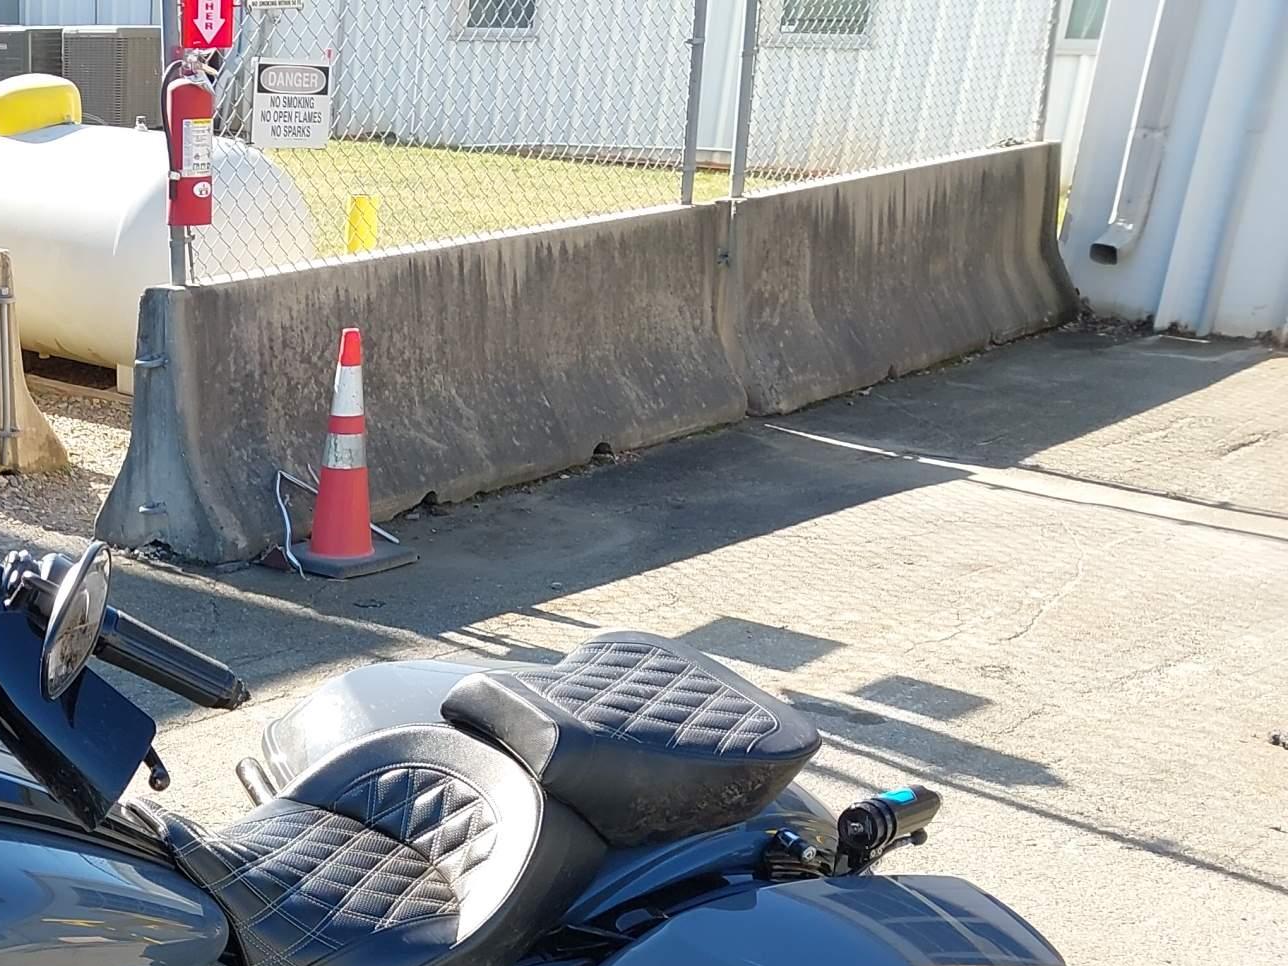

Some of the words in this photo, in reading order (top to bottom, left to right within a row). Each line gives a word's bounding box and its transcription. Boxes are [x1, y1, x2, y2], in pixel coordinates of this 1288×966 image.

[268, 71, 318, 88] DANGER
[270, 96, 281, 108] NO
[282, 96, 315, 109] SMOKING
[260, 110, 271, 122] NO
[272, 110, 292, 123] OPEN
[294, 111, 322, 123] FLAMES
[271, 125, 281, 137] NO
[283, 125, 311, 137] SPARKS
